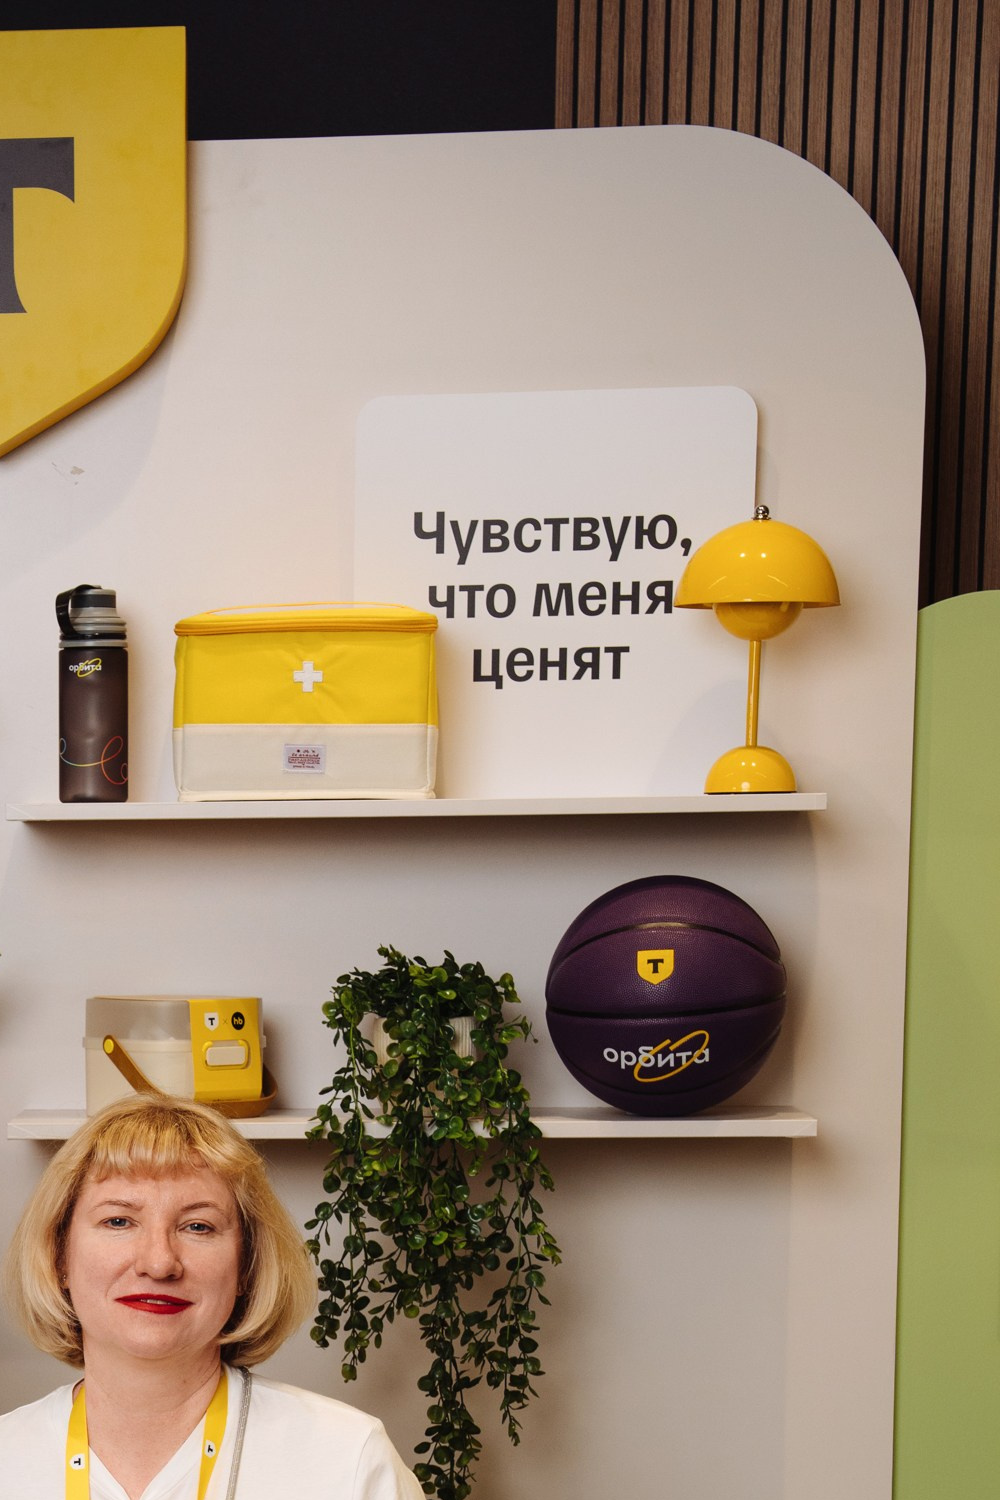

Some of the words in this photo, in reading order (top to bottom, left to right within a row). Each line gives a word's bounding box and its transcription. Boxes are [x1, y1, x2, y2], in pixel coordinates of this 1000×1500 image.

[413, 511, 692, 565] Чувствую,
[428, 583, 517, 619] что
[532, 580, 674, 617] меня
[68, 661, 102, 674] орбита
[472, 646, 630, 690] ценят
[646, 957, 665, 975] Т
[602, 1045, 710, 1071] орбита
